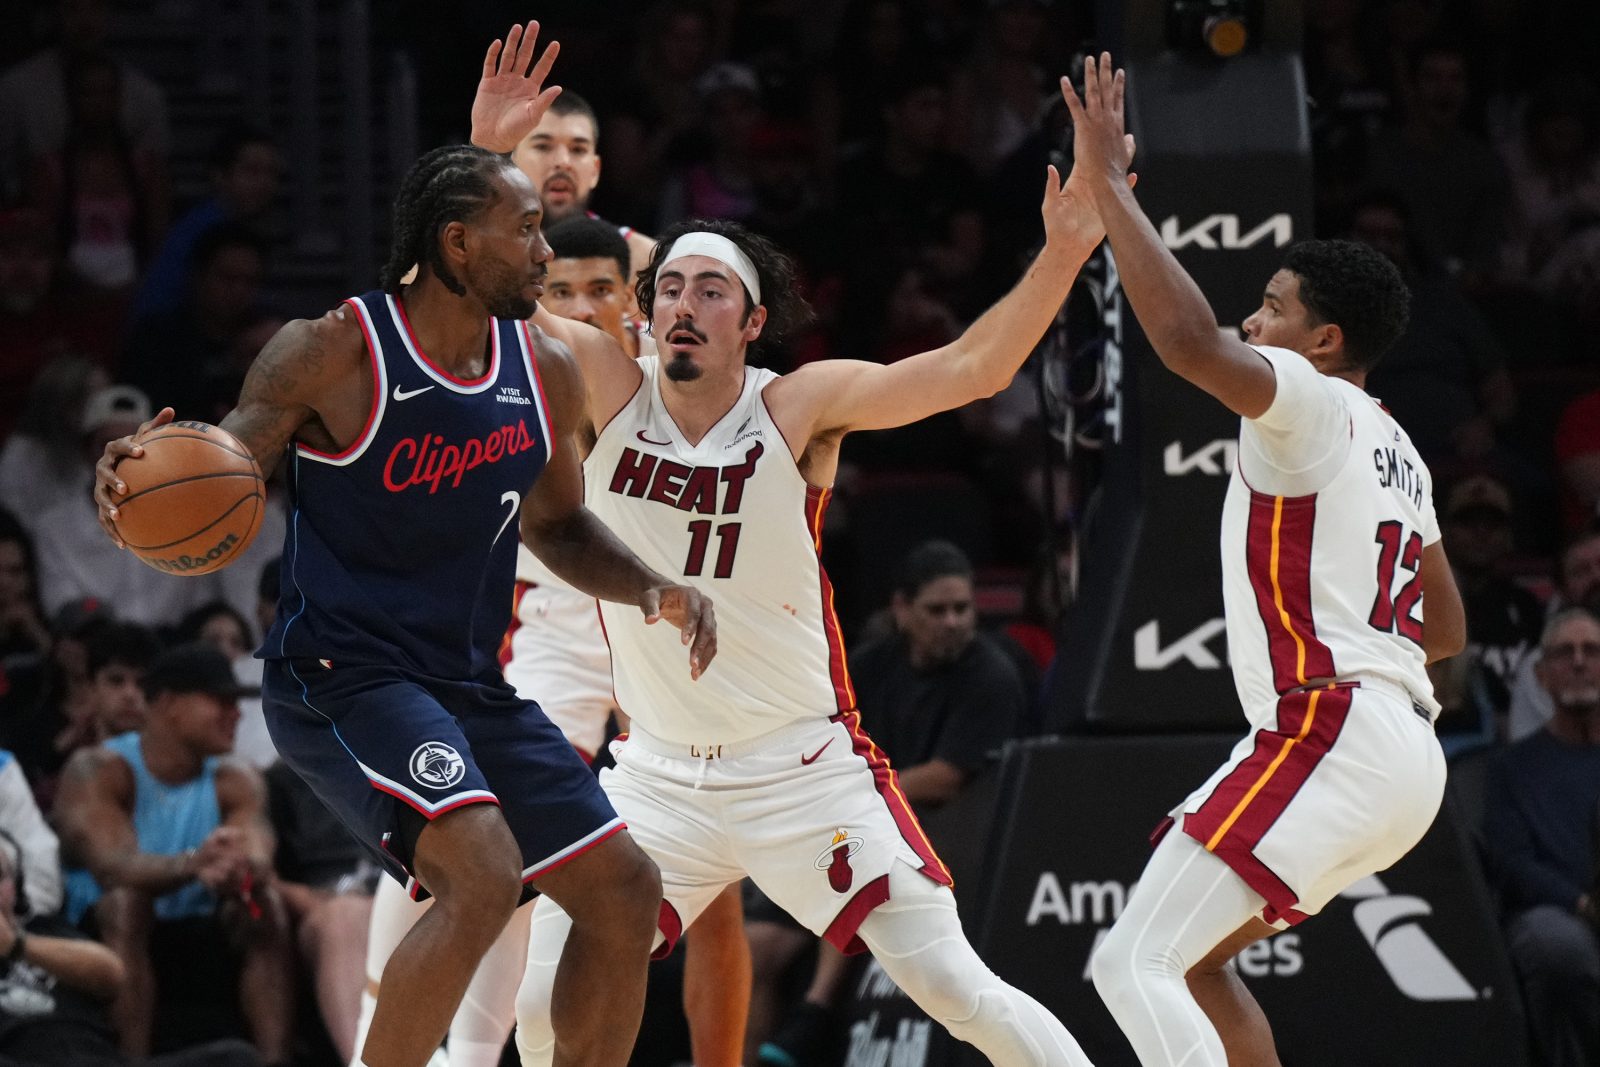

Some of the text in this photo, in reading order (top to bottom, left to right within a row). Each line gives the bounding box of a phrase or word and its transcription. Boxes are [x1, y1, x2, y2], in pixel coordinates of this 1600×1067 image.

[1160, 213, 1292, 249] KIA
[1103, 243, 1122, 444] AT&T
[495, 394, 532, 405] RWANDA
[500, 386, 520, 397] VISIT
[383, 418, 535, 494] Clippers
[608, 440, 764, 515] HEAT
[1373, 447, 1423, 512] SMITH
[144, 533, 239, 572] Wilson
[683, 519, 742, 579] 11
[1368, 519, 1424, 649] 12
